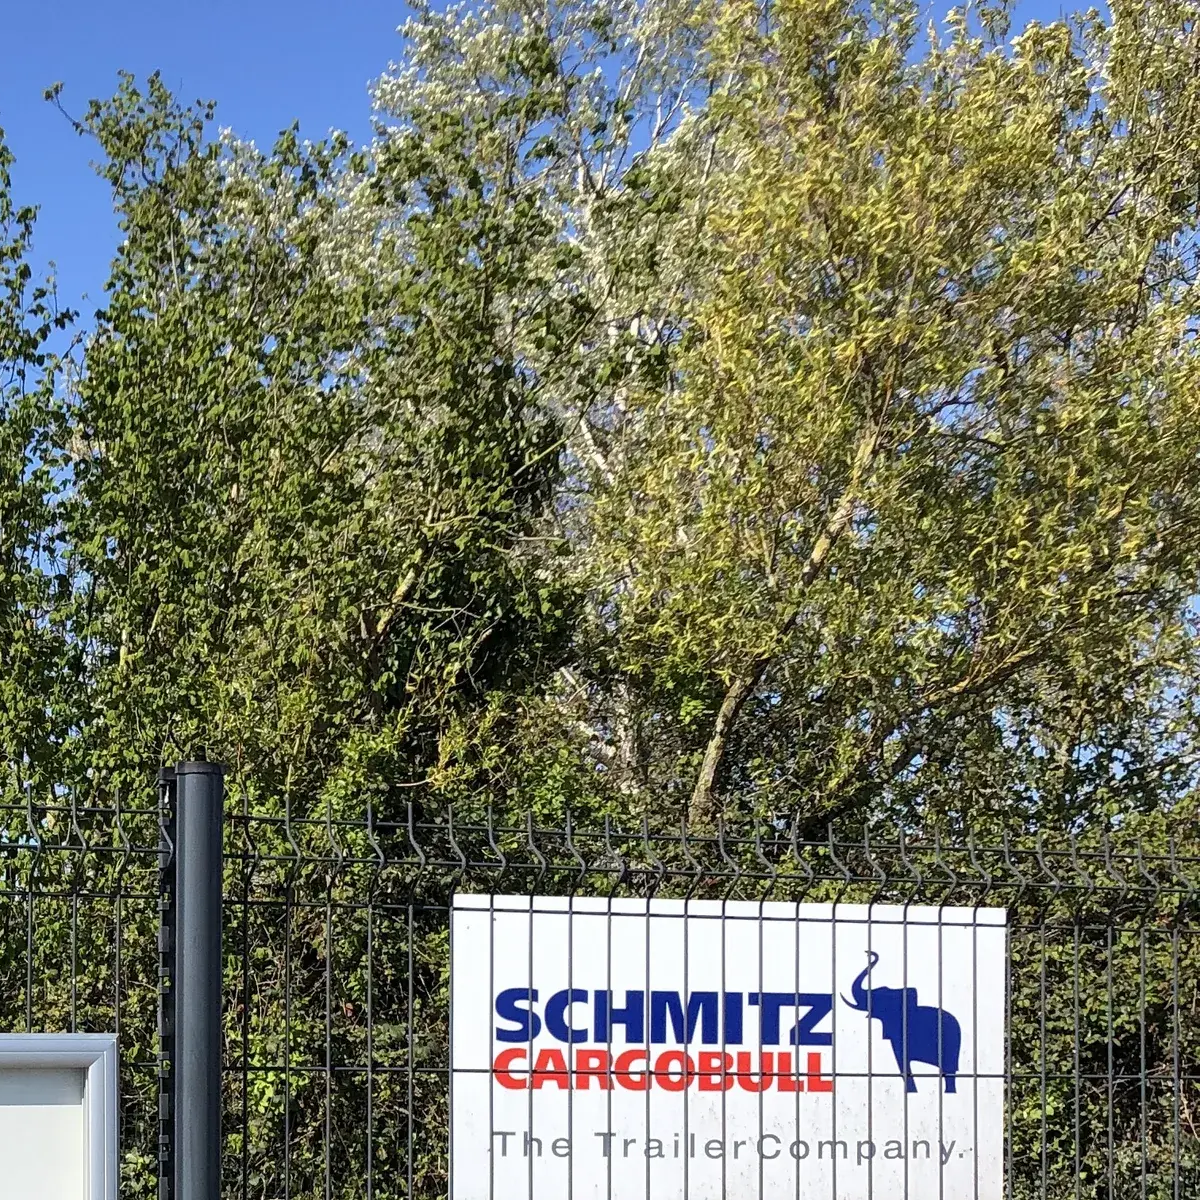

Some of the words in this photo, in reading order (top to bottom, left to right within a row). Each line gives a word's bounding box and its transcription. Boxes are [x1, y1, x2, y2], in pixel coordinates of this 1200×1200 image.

[494, 986, 833, 1046] SCHMITZ
[493, 1047, 834, 1093] CARGOBULL
[492, 1131, 571, 1159] The
